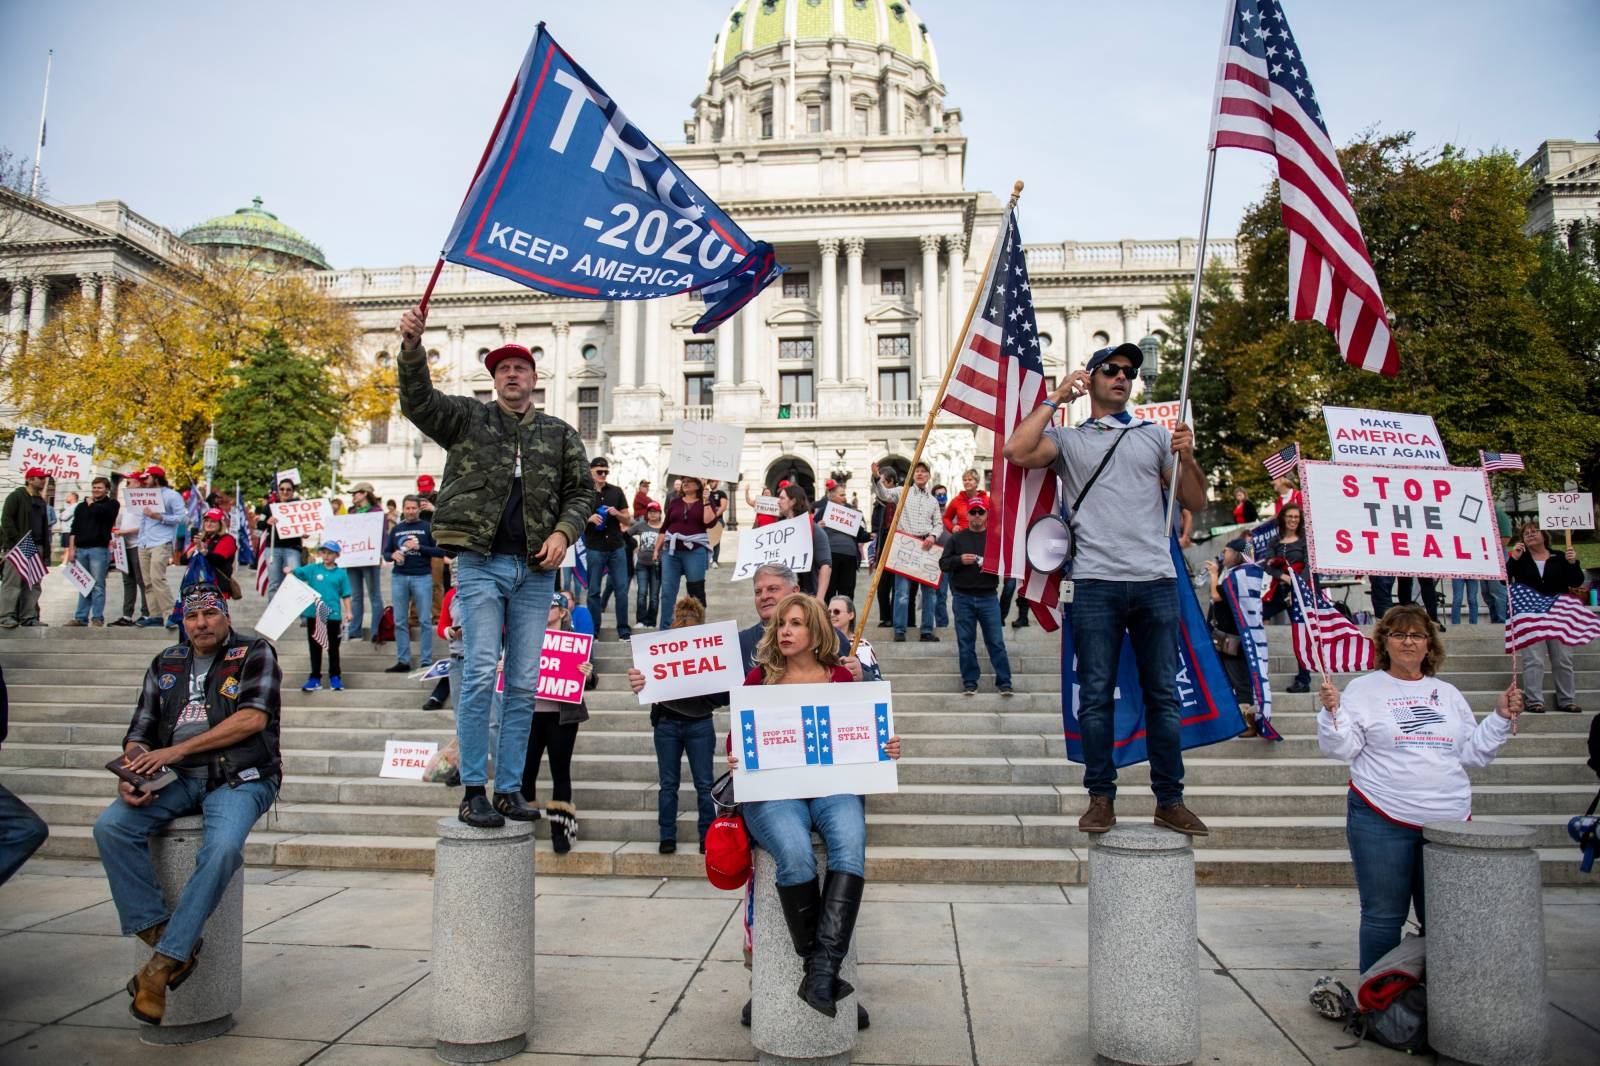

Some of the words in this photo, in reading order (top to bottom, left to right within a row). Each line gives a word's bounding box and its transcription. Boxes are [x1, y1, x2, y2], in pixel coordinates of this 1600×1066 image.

[549, 68, 704, 222] TRU
[488, 221, 569, 266] KEEP
[571, 254, 695, 289] AMERICA
[1360, 418, 1403, 430] MAKE
[1336, 428, 1436, 447] AMERICA
[23, 448, 47, 465] Say
[48, 453, 65, 466] No
[66, 454, 79, 468] To
[1338, 444, 1387, 456] GREAT
[1393, 447, 1441, 460] AGAIN
[1342, 475, 1452, 503] STOP
[1547, 494, 1580, 504] STOP
[278, 501, 323, 515] STOP
[831, 507, 845, 515] STOP
[286, 513, 321, 524] THE
[829, 514, 854, 527] STEAL
[1363, 502, 1443, 530] THE
[1546, 512, 1592, 528] STEAL!
[280, 523, 325, 536] STEA
[755, 526, 795, 549] STOP
[1335, 529, 1489, 560] STEAL!
[764, 548, 781, 560] THE
[70, 567, 89, 588] STEAL
[542, 634, 588, 654] MEN
[649, 640, 689, 656] STOP
[693, 635, 724, 649] THE
[540, 656, 561, 671] OR
[653, 656, 727, 680] STEAL
[763, 729, 781, 737] STOP
[838, 732, 870, 741] STEAL
[763, 736, 797, 746] STEAL
[394, 748, 413, 756] STOP
[415, 748, 430, 756] THE
[392, 758, 426, 768] STEAL
